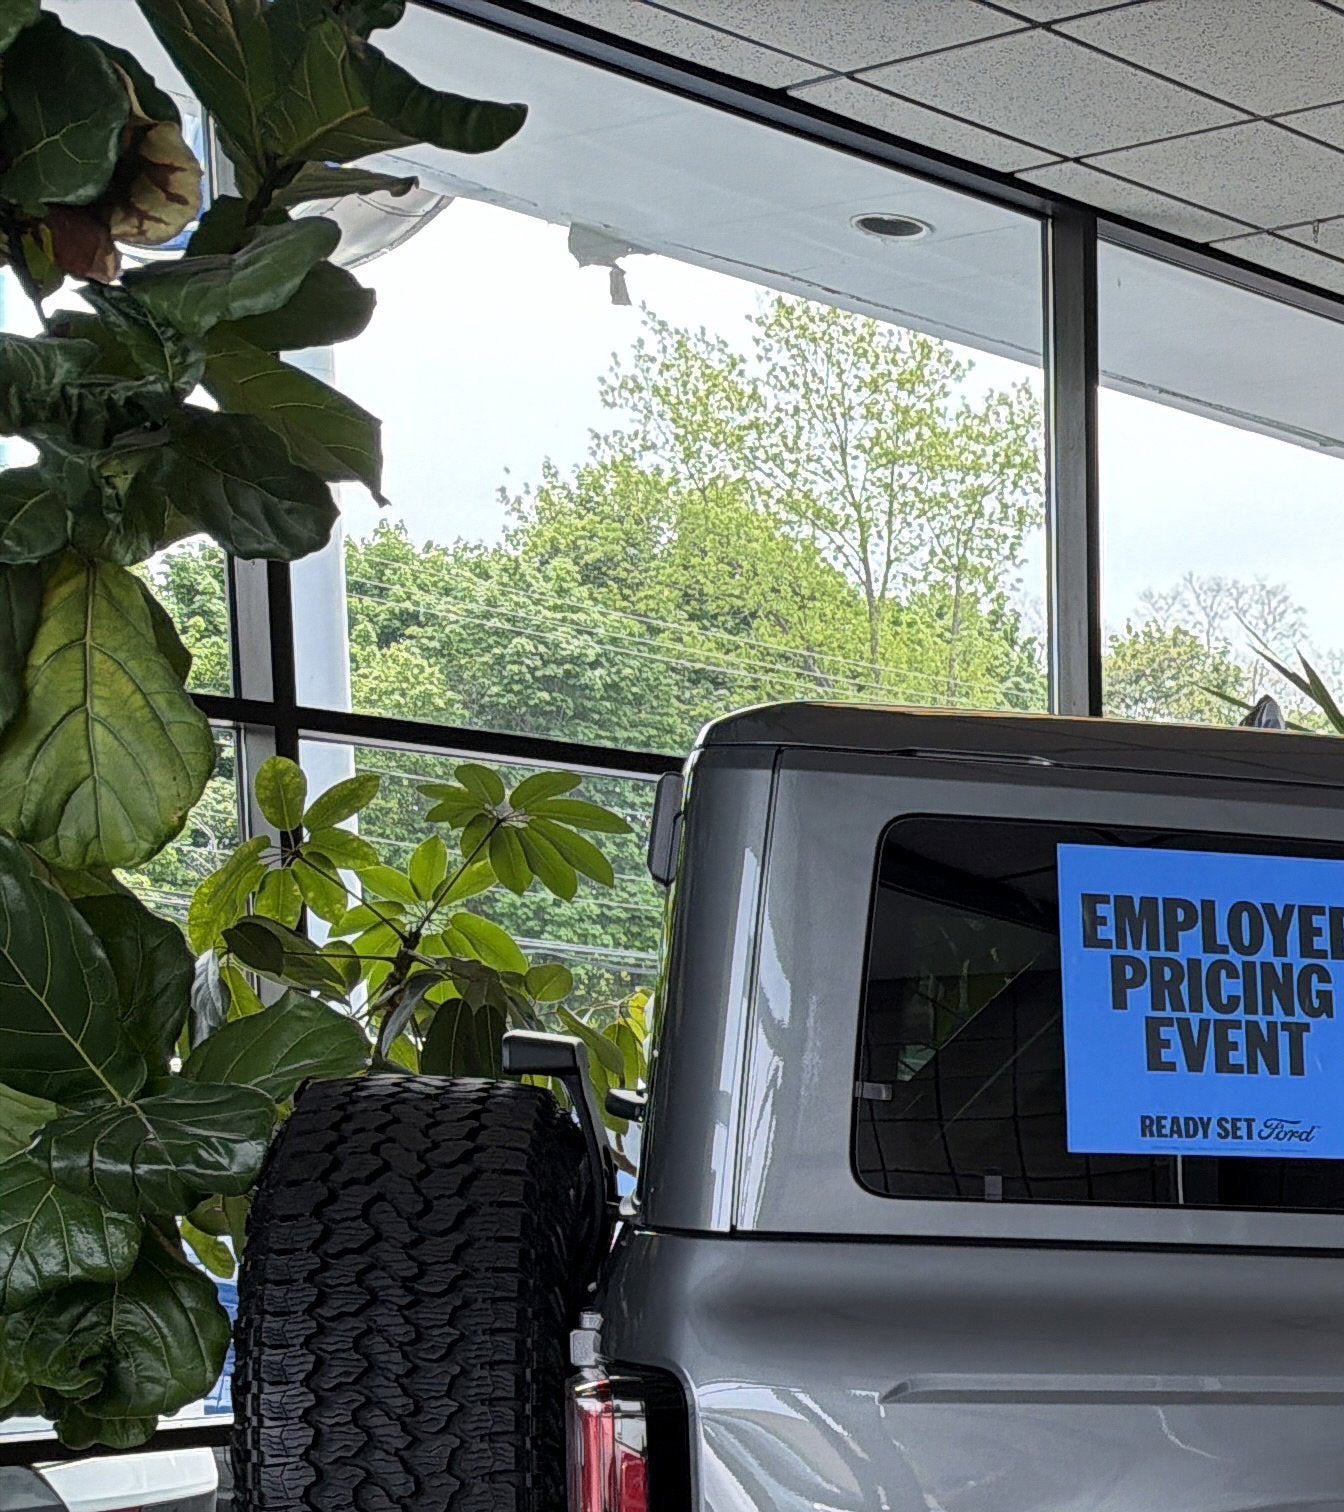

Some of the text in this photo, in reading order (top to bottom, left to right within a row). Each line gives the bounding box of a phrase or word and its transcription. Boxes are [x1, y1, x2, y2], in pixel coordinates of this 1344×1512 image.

[1111, 955, 1334, 1018] PRICING
[1145, 1016, 1310, 1076] EVENT
[1140, 1115, 1317, 1142] READY SET Ford
